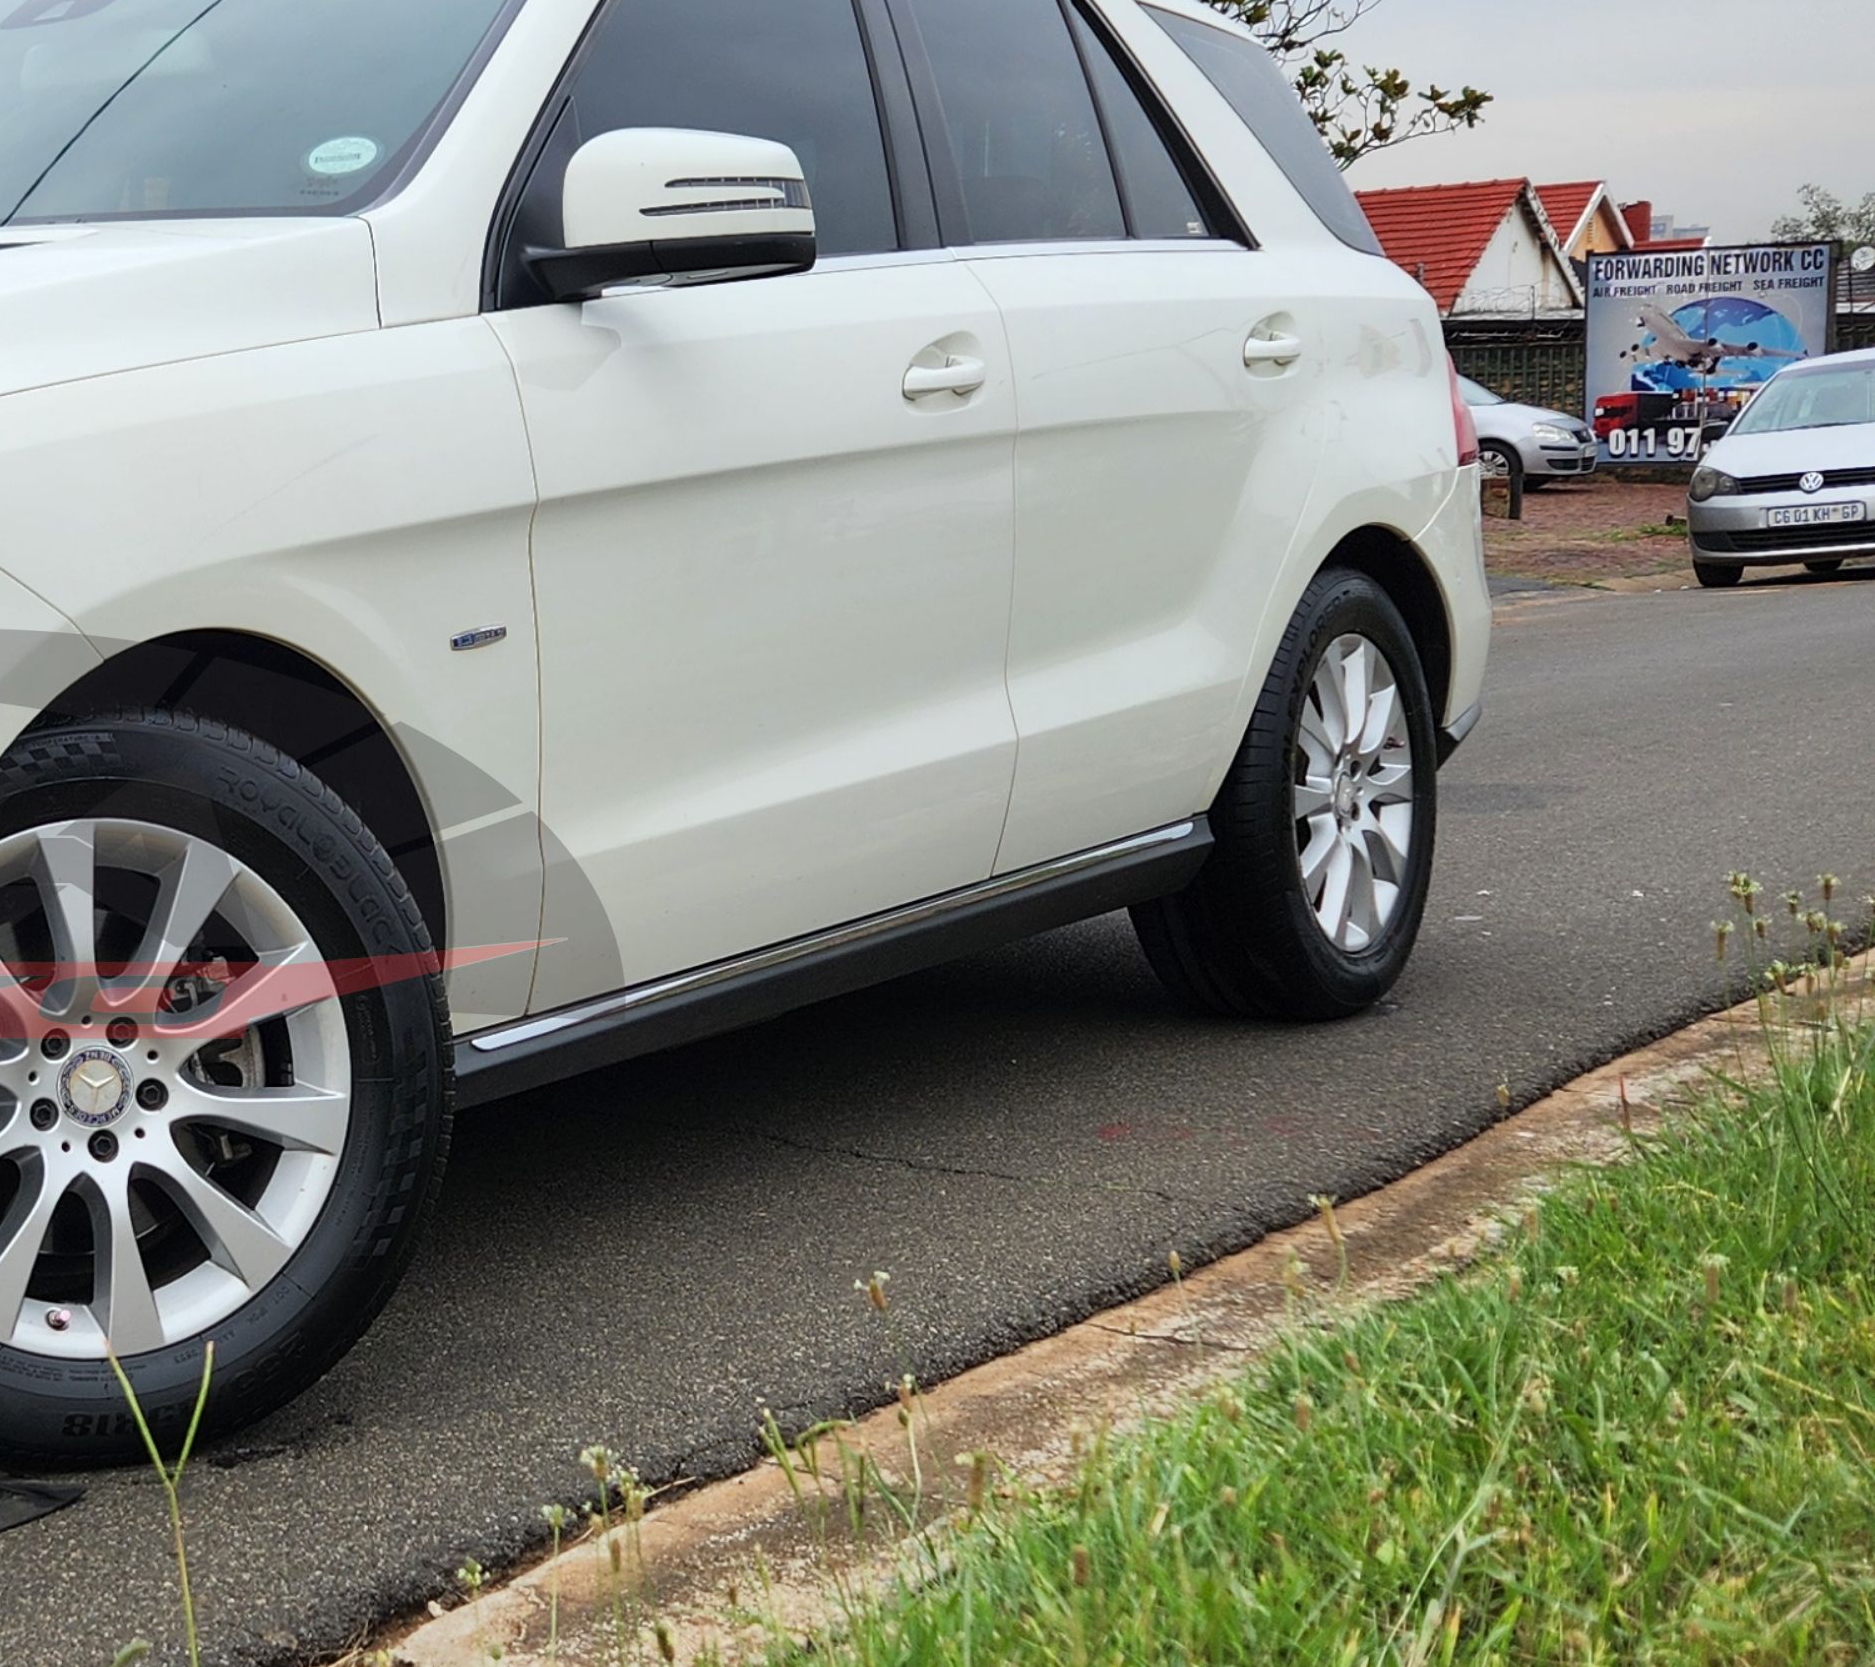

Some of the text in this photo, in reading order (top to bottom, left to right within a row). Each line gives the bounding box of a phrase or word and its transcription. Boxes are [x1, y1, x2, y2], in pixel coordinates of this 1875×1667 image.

[1594, 248, 1824, 281] FORWARDING NETWORK CC
[1593, 276, 1825, 297] AIR FREIGHT ROAD FREIGHT SEA FREIGHT
[1609, 427, 1656, 456] 011
[1667, 426, 1701, 455] 97
